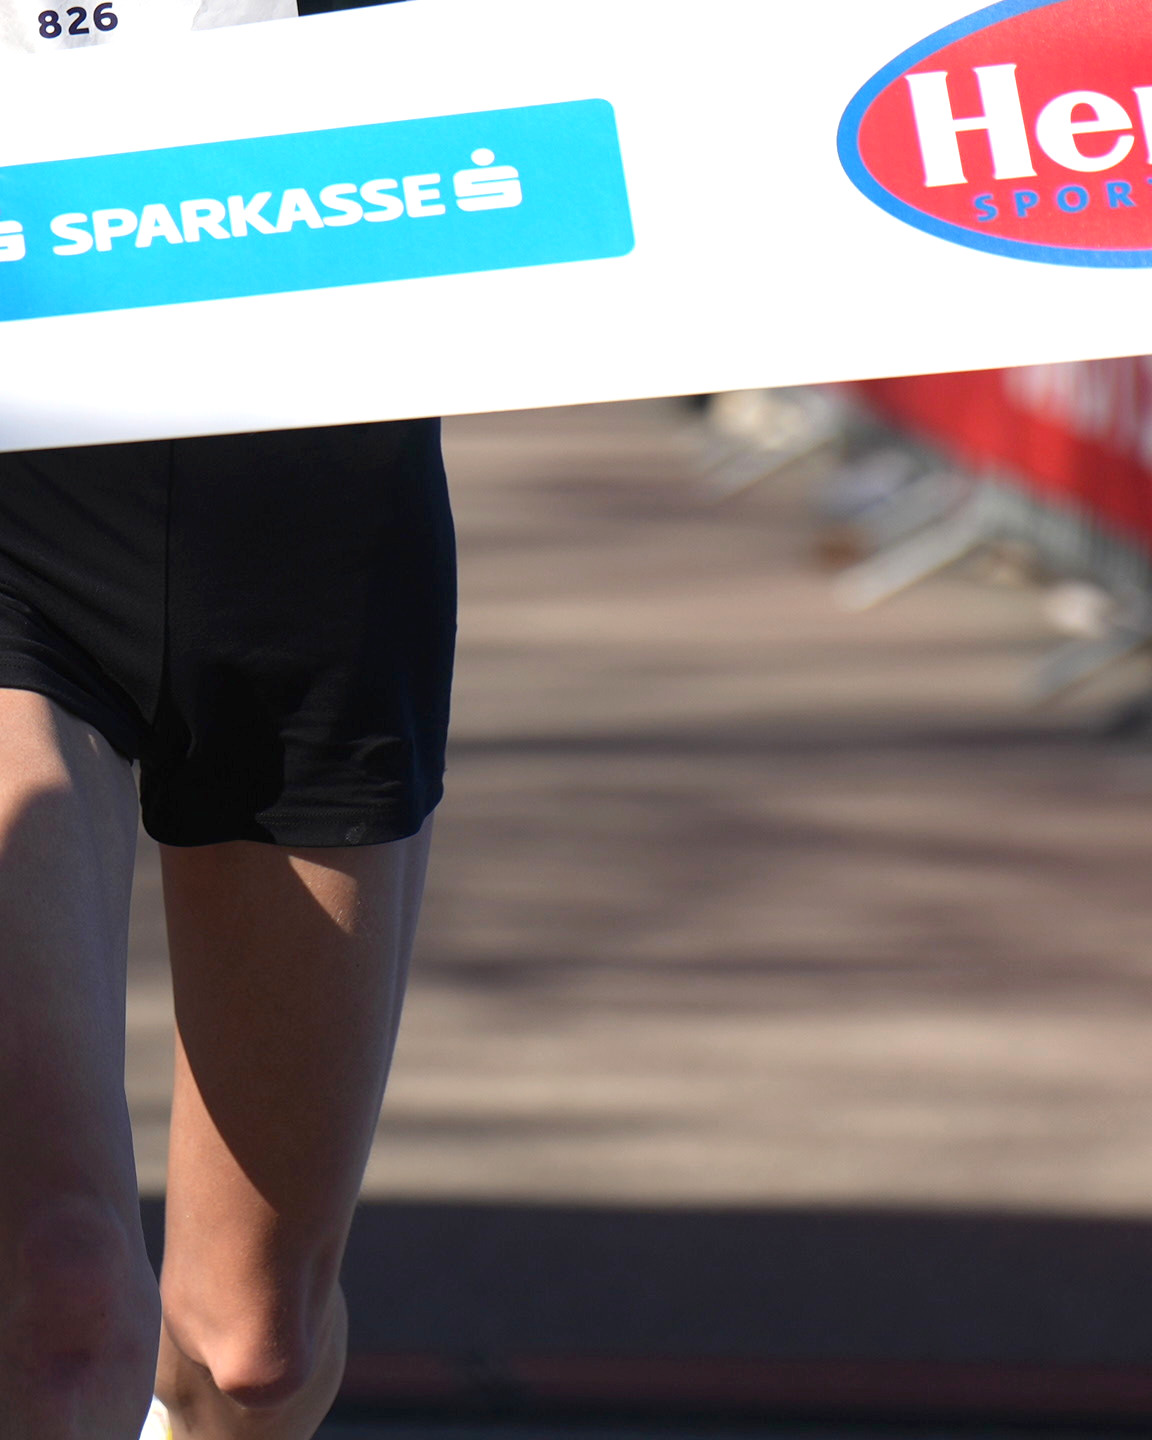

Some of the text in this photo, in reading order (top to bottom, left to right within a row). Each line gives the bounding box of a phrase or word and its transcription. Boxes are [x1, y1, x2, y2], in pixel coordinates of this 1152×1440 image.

[38, 2, 119, 39] 826
[49, 172, 447, 257] SPARKASSE
[973, 177, 1152, 222] SPOR
